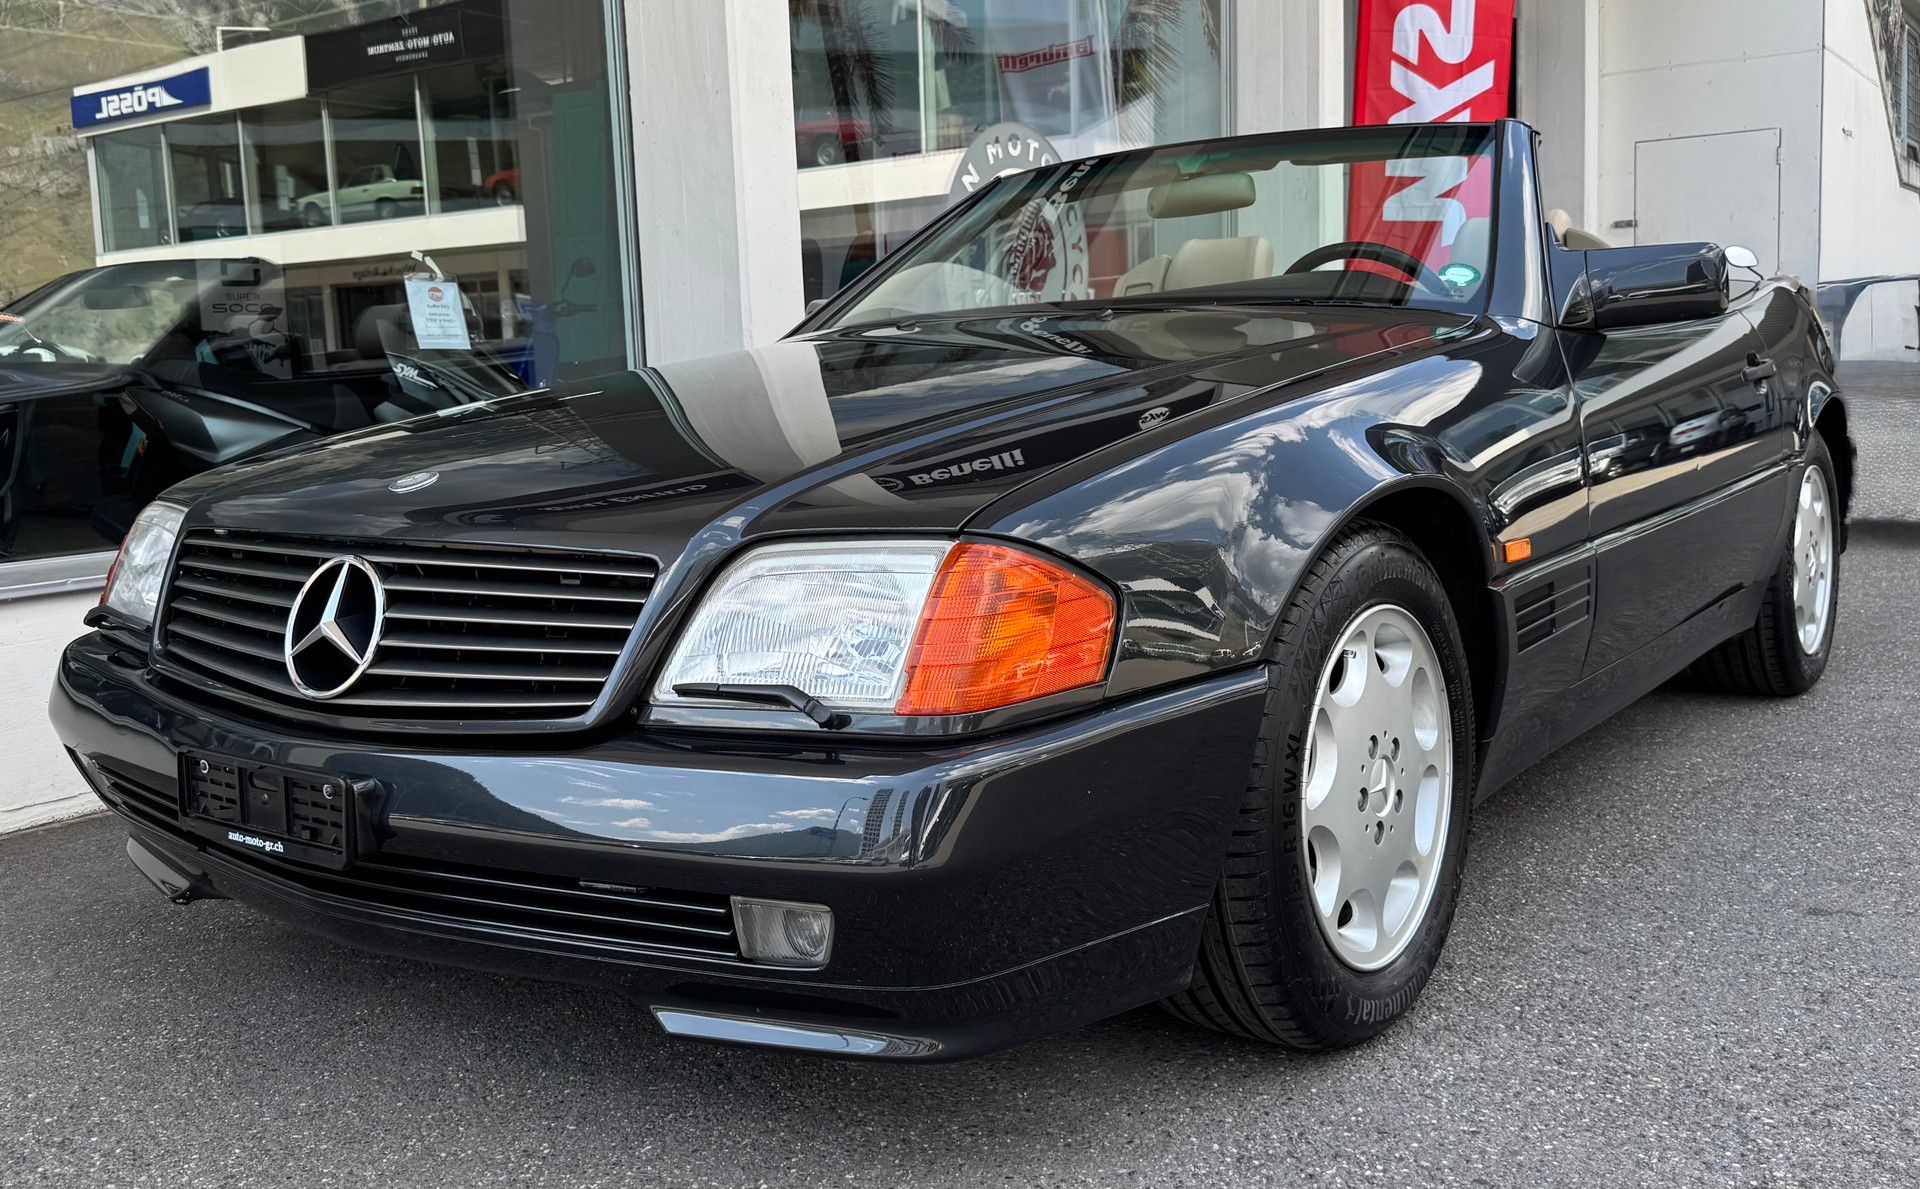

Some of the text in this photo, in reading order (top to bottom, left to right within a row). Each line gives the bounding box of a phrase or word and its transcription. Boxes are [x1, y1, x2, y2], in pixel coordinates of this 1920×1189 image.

[226, 292, 260, 301] SUPER
[1284, 729, 1303, 763] XL
[1282, 766, 1298, 796] W
[1282, 801, 1297, 831] 16
[228, 831, 284, 853] auto-moto-gr.ch
